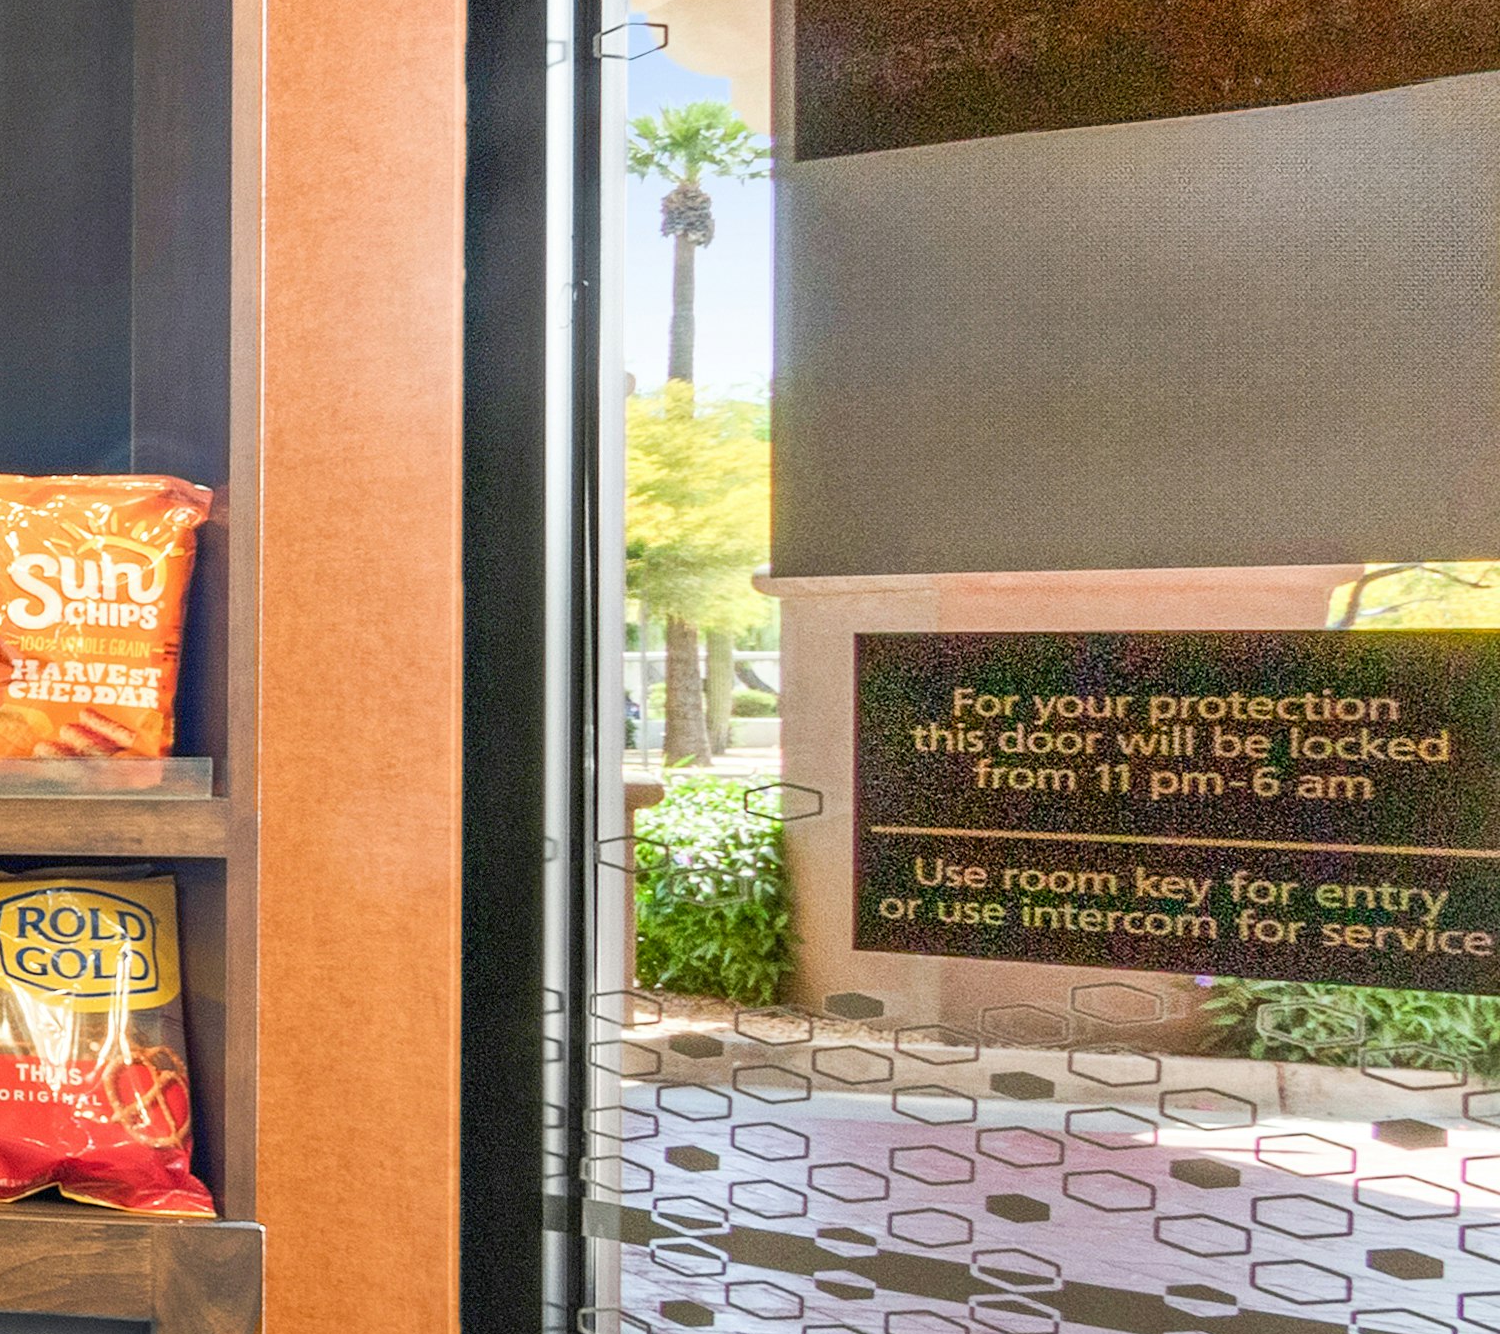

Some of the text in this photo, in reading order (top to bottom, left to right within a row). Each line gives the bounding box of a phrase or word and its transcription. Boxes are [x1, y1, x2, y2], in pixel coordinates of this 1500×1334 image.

[8, 553, 168, 630] Sun
[62, 602, 158, 630] CHIPS
[10, 658, 161, 685] HARVEST
[8, 682, 159, 709] CHEDDAR
[953, 688, 1399, 726] For your protection
[912, 723, 1450, 763] this door will be locked
[973, 760, 1373, 801] from 11 pm-6 am
[916, 859, 1448, 917] Use room key for entry
[15, 902, 148, 945] ROLD
[880, 897, 1495, 956] or use intercom for service
[15, 944, 152, 983] GOLD
